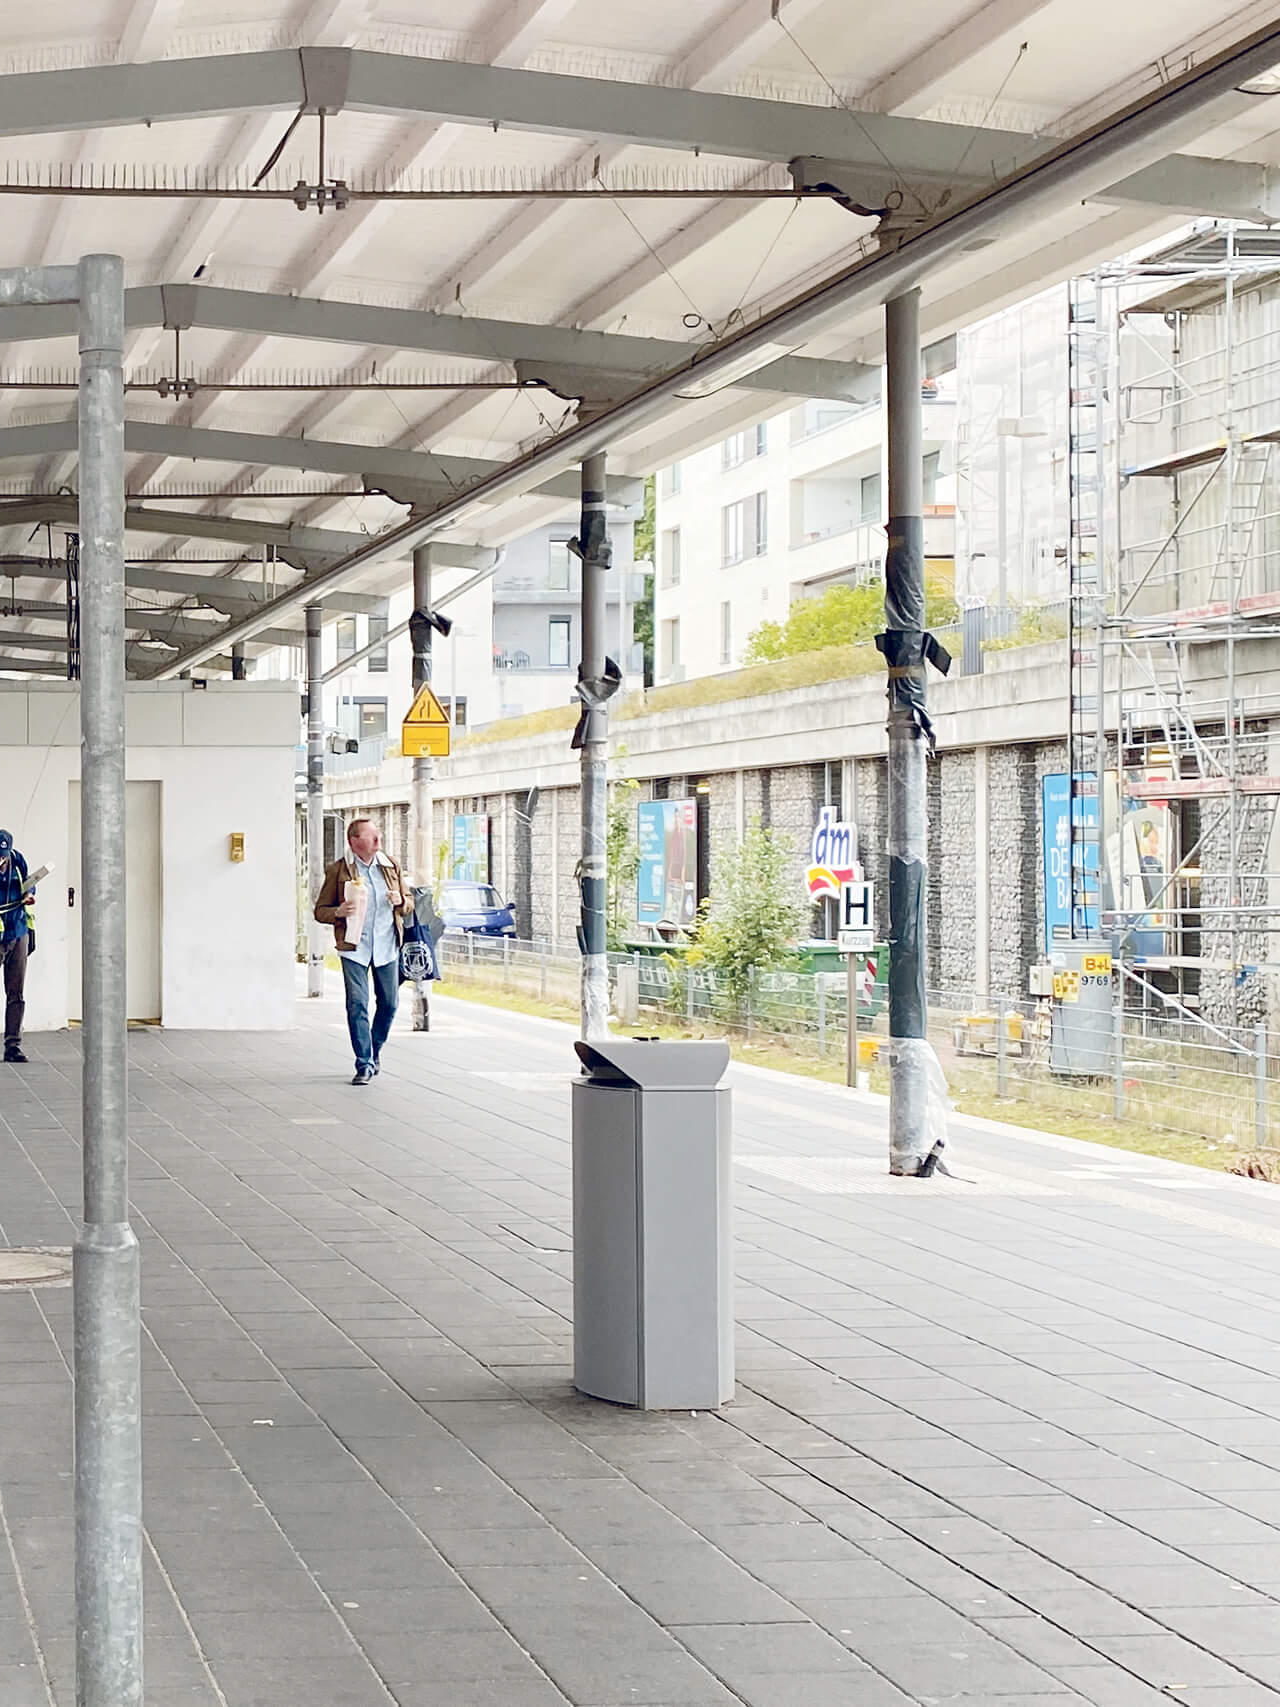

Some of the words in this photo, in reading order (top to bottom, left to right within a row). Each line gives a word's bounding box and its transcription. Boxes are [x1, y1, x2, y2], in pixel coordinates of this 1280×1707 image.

[815, 812, 851, 865] dm
[845, 887, 869, 925] H
[1085, 958, 1110, 971] B+L
